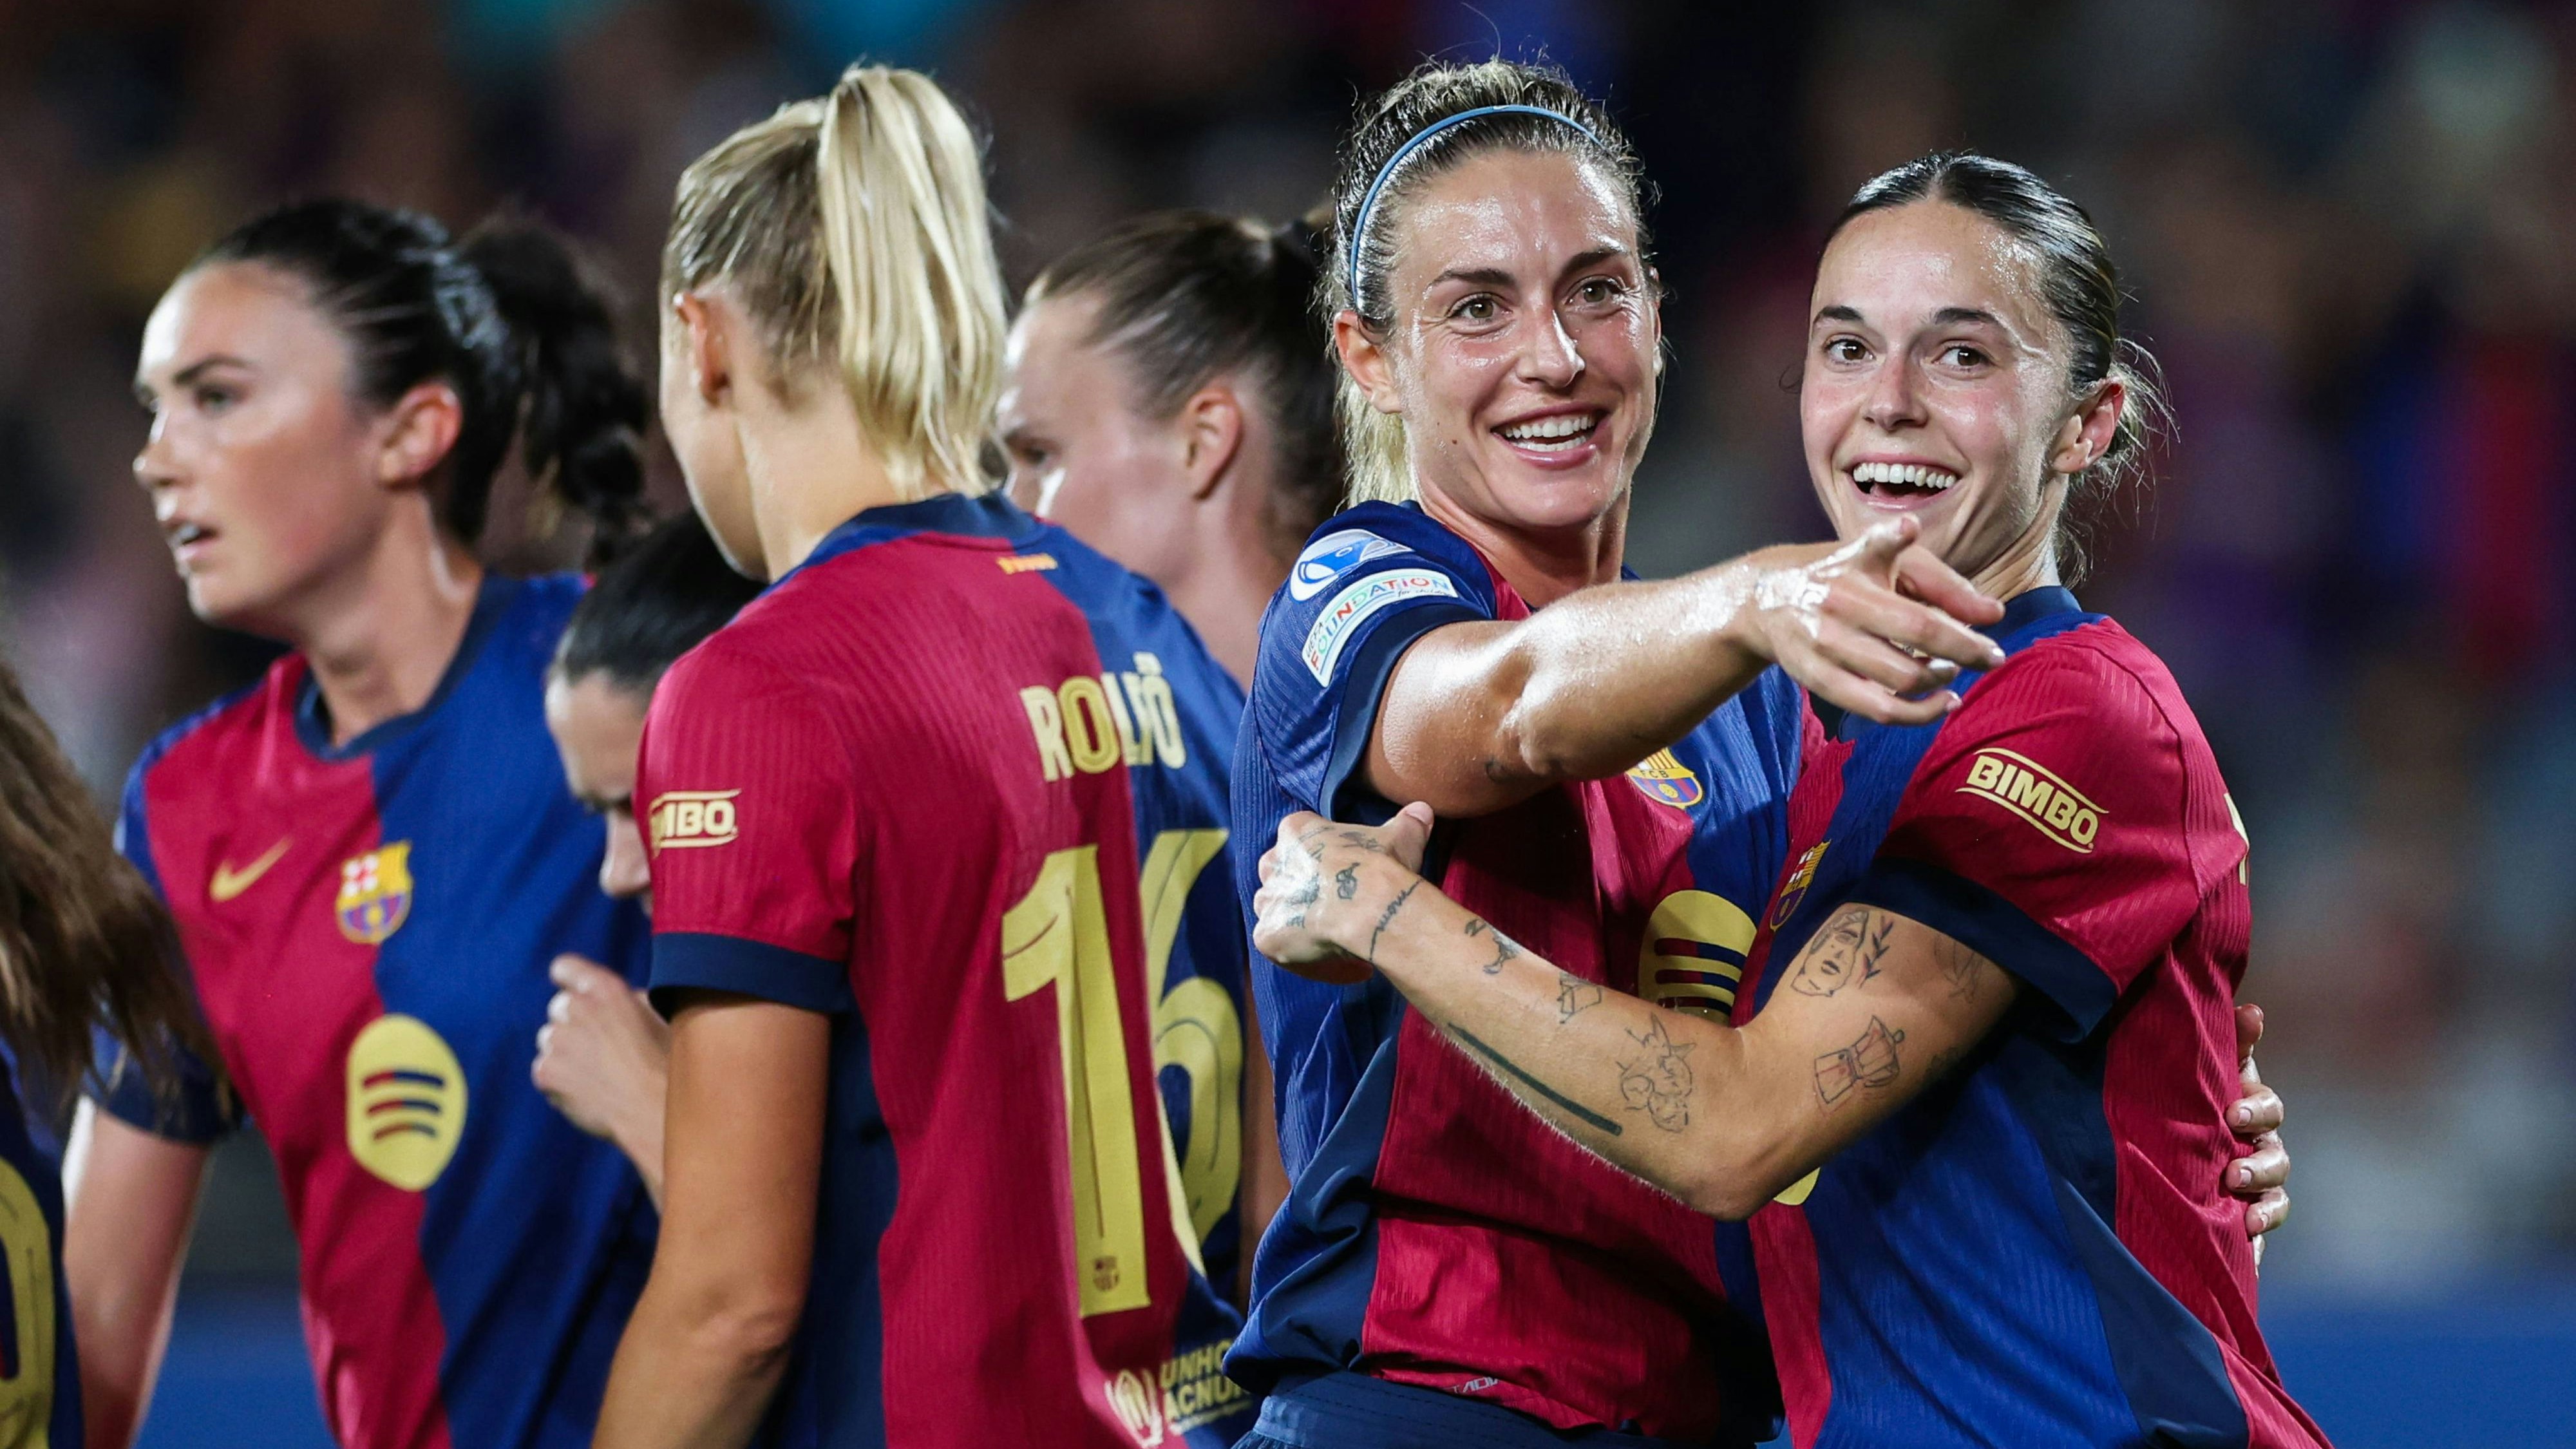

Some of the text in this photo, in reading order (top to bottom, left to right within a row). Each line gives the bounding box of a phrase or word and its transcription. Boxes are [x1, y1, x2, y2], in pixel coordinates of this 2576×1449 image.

[1311, 577, 1448, 671] FOUNDATION
[1397, 589, 1410, 598] for
[1966, 755, 2099, 845] BIMBO
[1001, 828, 1244, 1318] 16
[1160, 1339, 1233, 1388] UNHC
